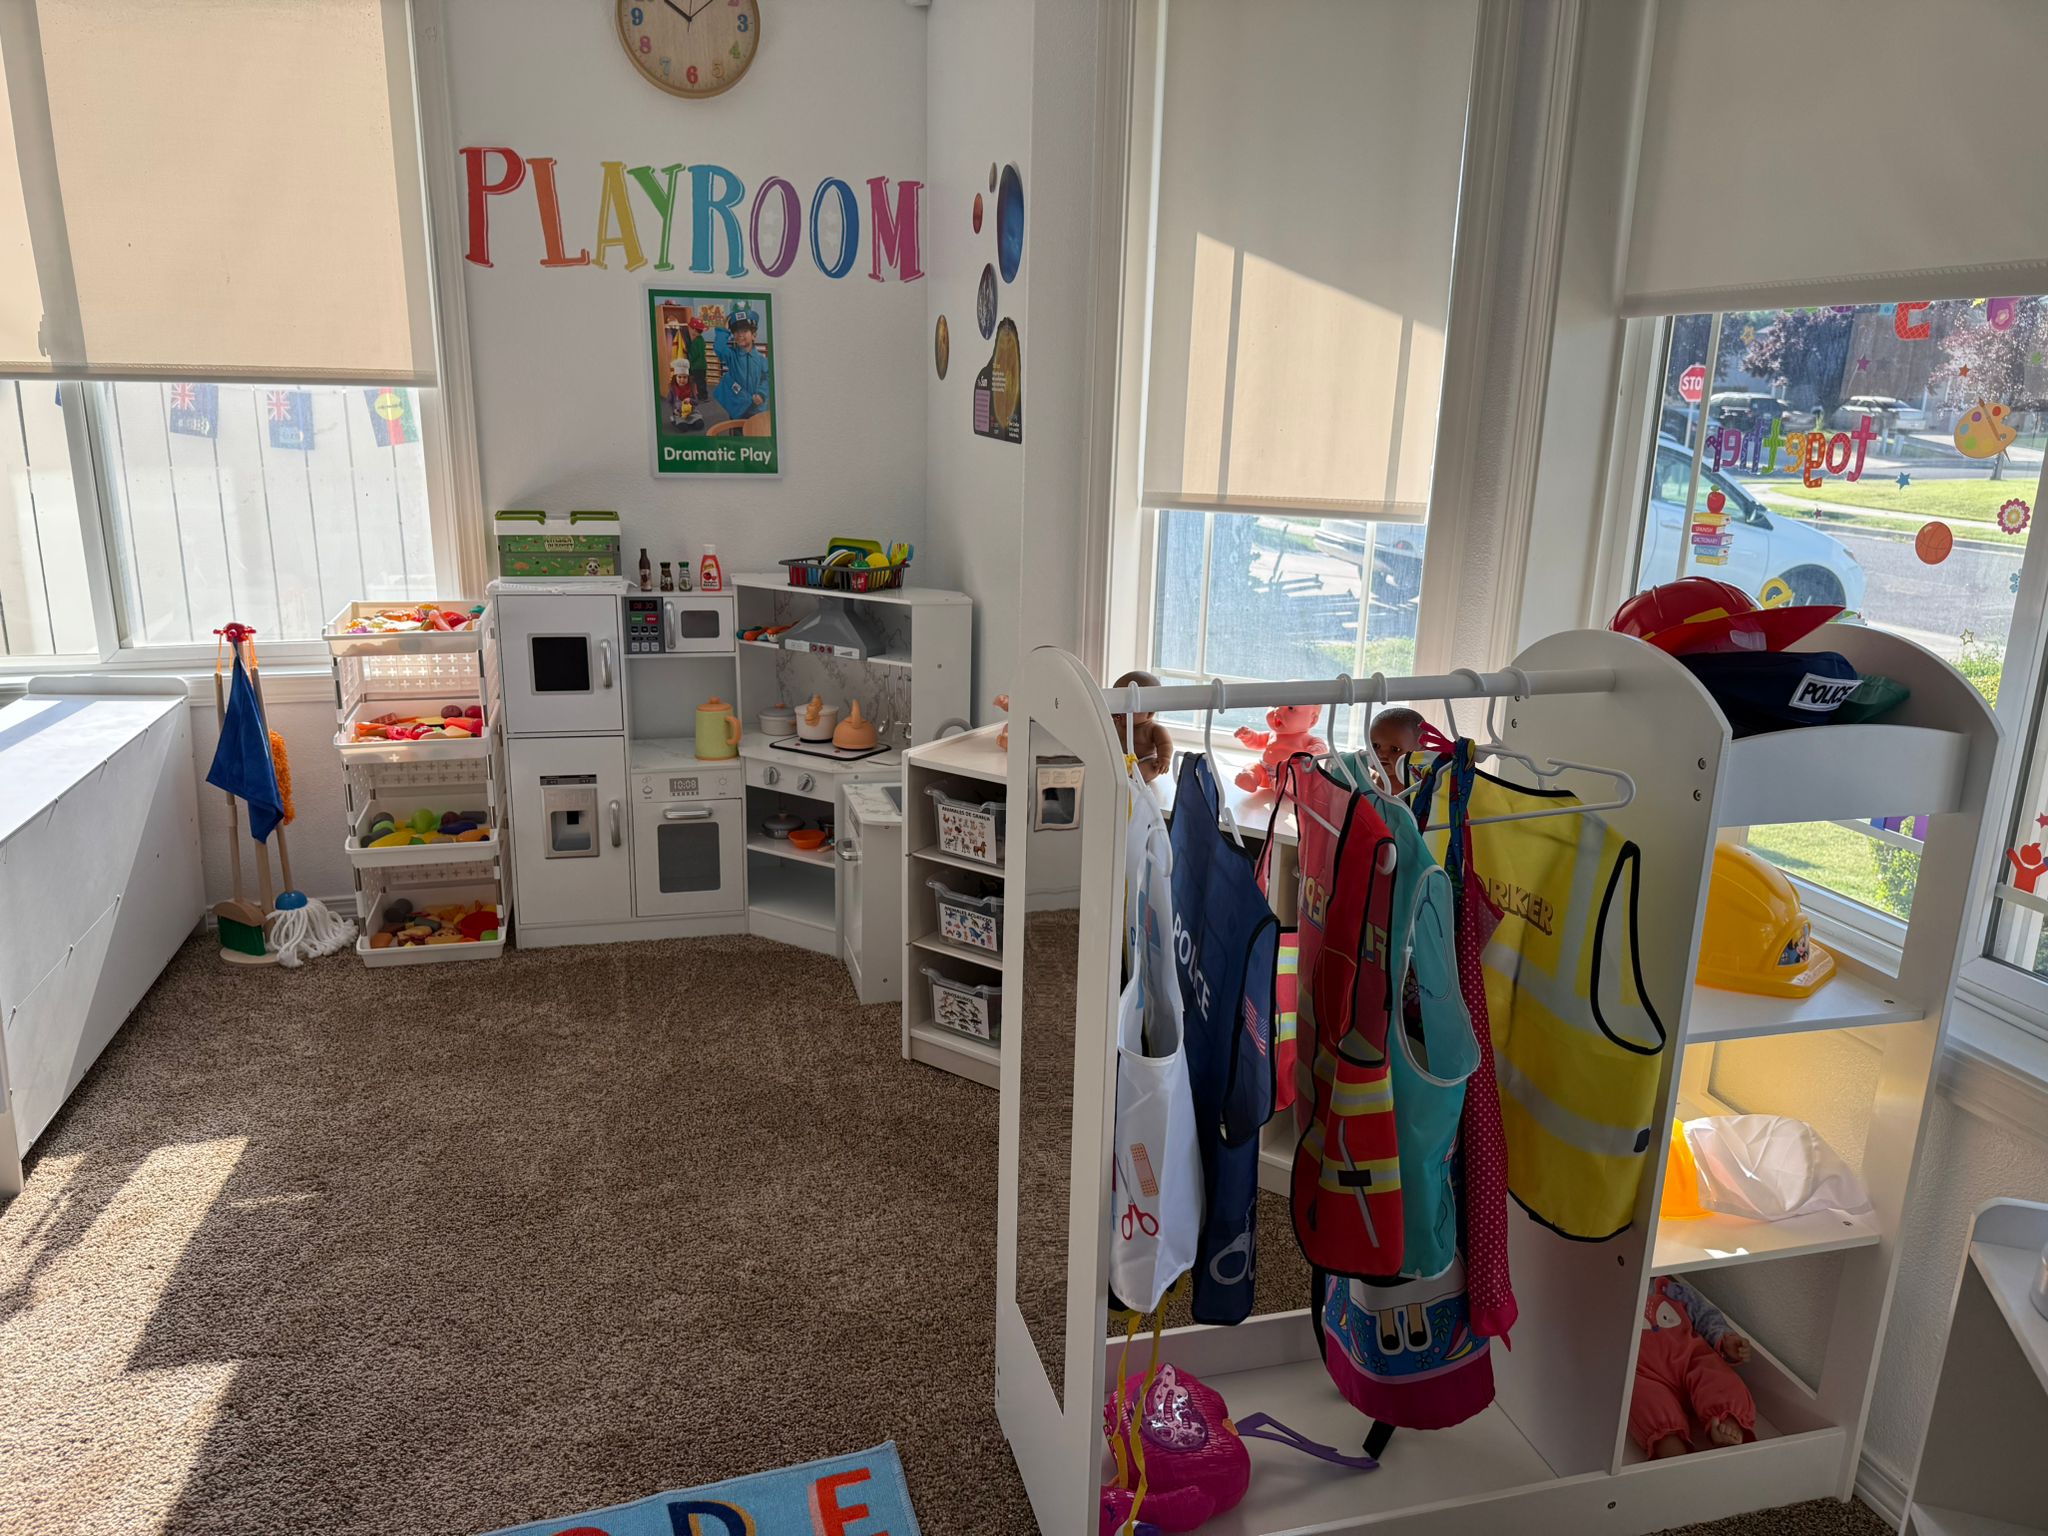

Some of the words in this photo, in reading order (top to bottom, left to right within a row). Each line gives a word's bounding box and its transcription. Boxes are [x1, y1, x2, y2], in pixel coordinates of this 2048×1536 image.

[631, 7, 644, 26] 9
[737, 14, 748, 32] 3
[639, 35, 652, 54] 8
[729, 41, 741, 59] 4
[659, 57, 672, 77] 7
[686, 65, 698, 84] 6
[711, 62, 725, 79] 5
[459, 146, 925, 284] PLAYROOM
[1682, 376, 1704, 391] STO
[663, 446, 737, 462] Dramatic
[740, 447, 772, 465] Play
[1486, 878, 1554, 936] RKER
[1173, 912, 1211, 1022] POLICE
